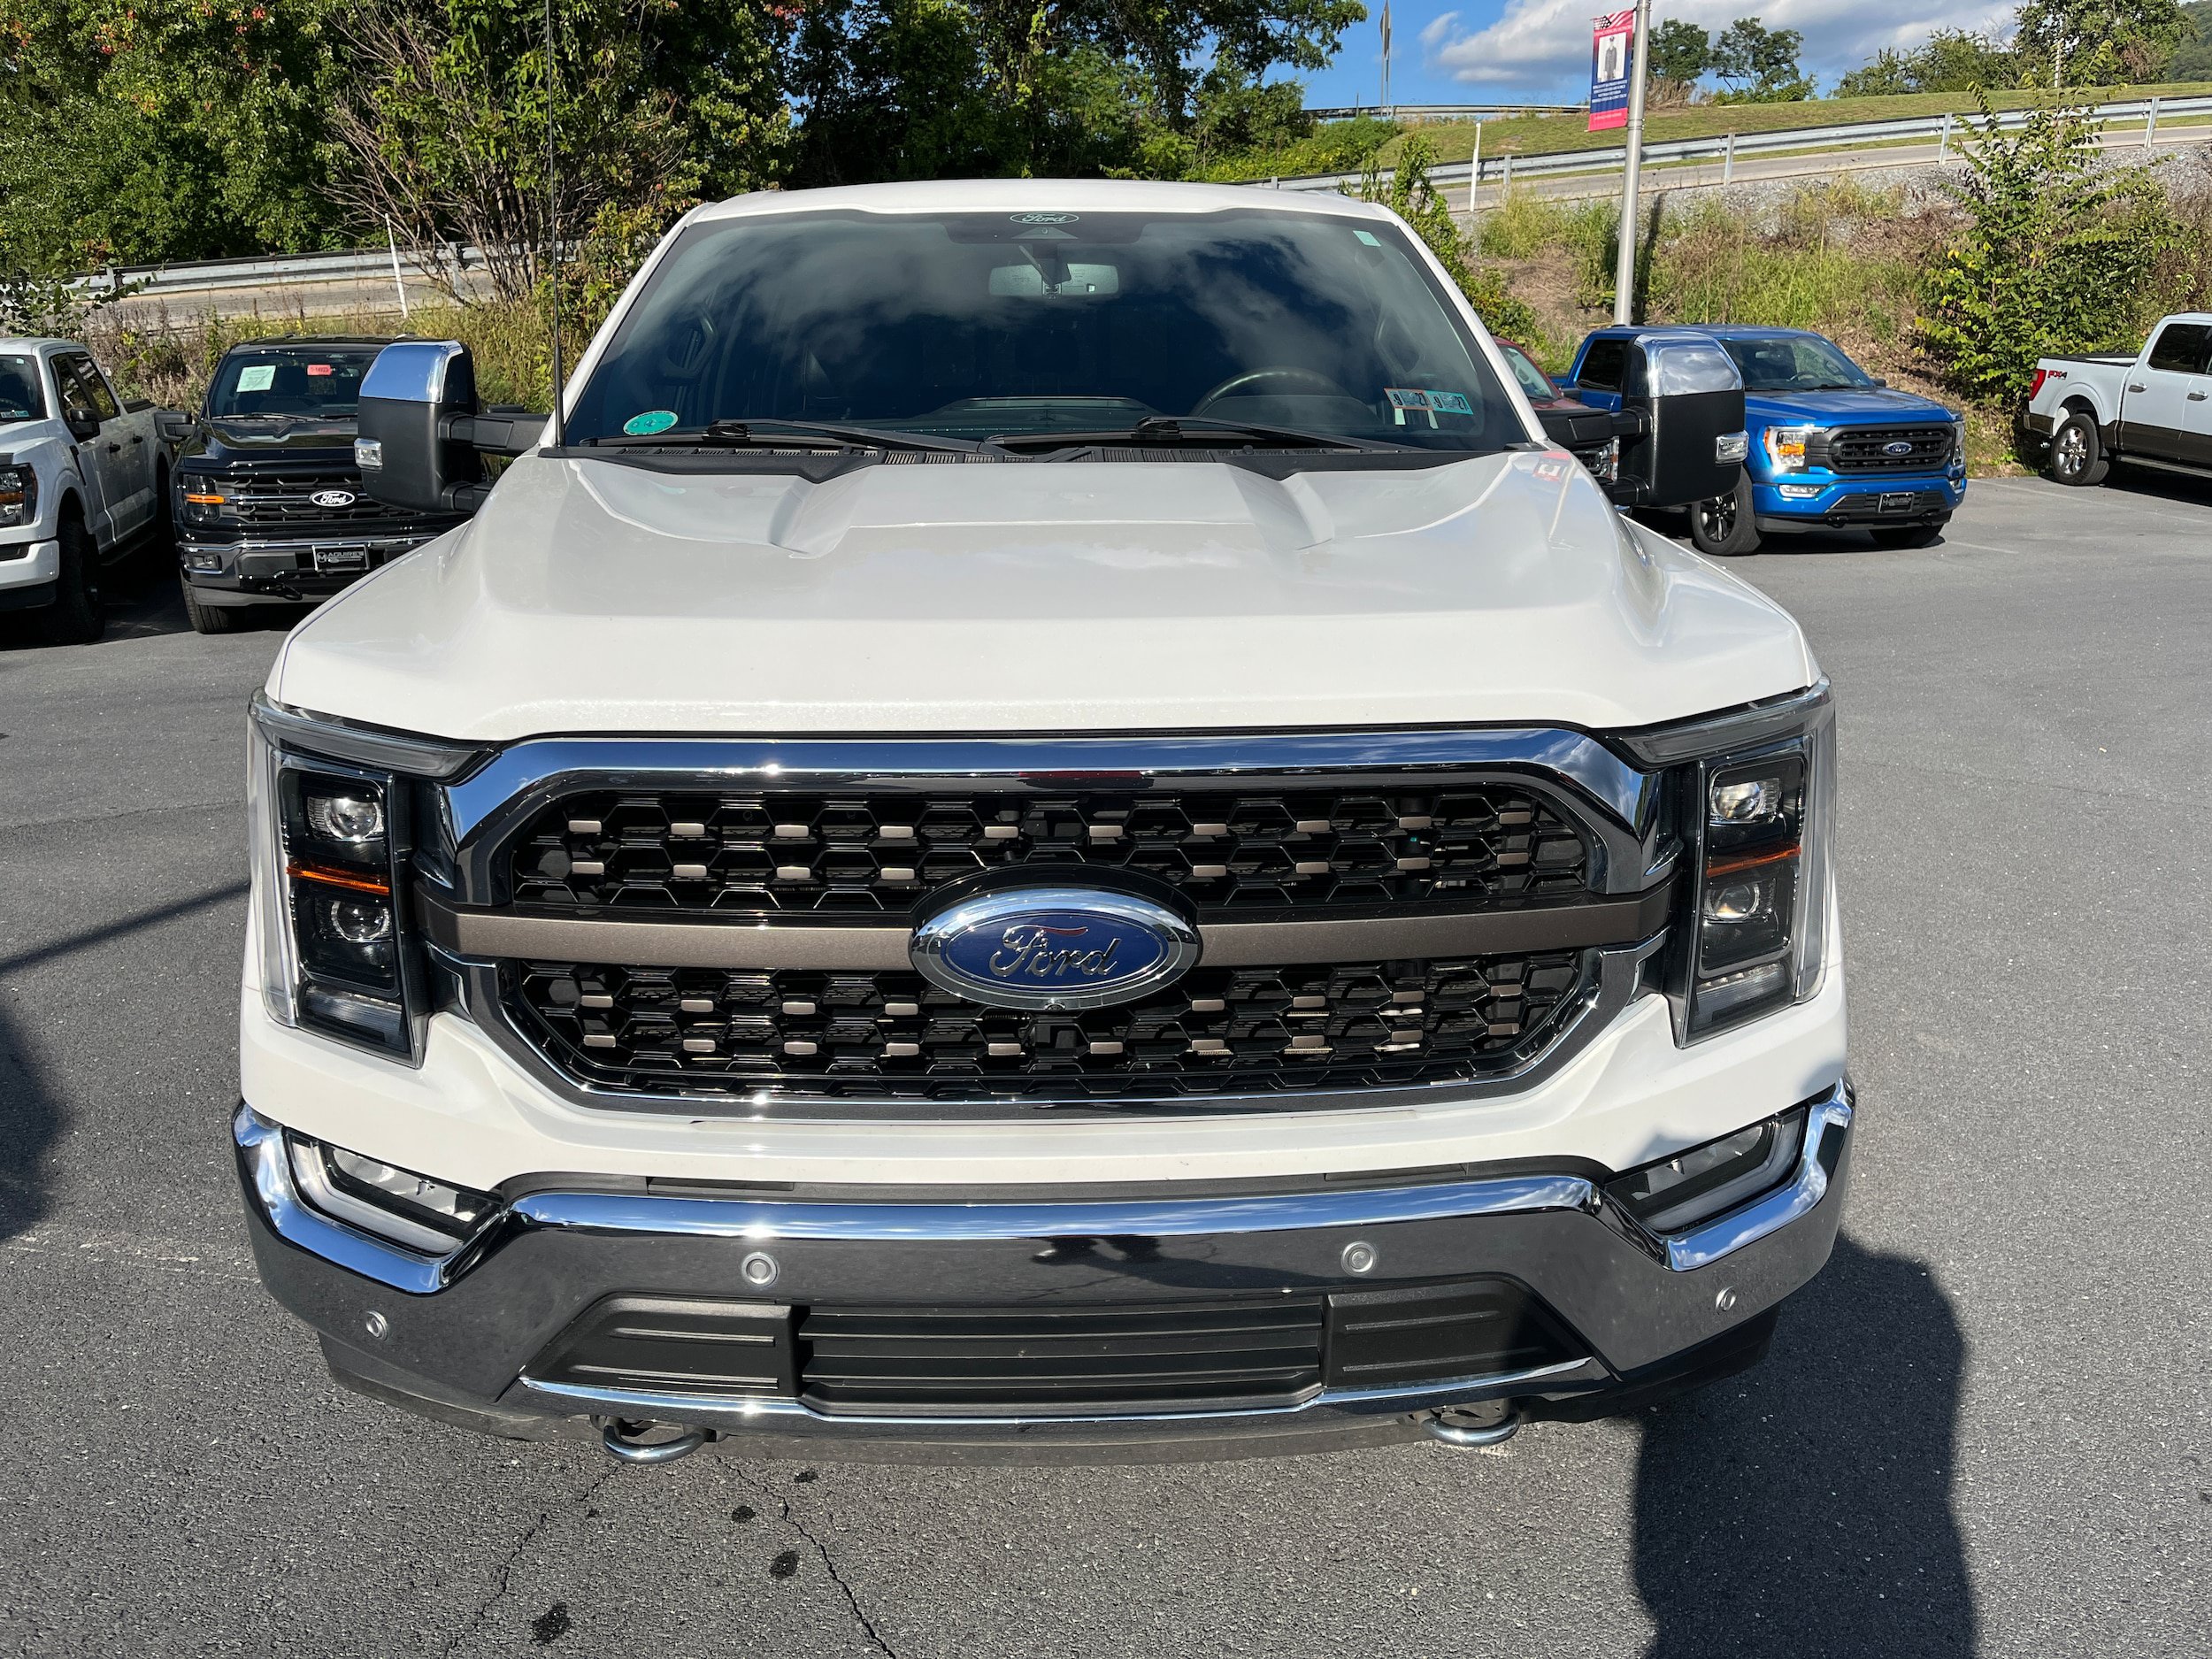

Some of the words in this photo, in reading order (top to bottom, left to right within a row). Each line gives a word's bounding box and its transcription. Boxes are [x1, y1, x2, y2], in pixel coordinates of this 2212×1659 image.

[1021, 213, 1067, 222] Ford
[2047, 370, 2068, 379] FX4
[320, 493, 346, 503] Ford
[989, 925, 1122, 977] Ford
